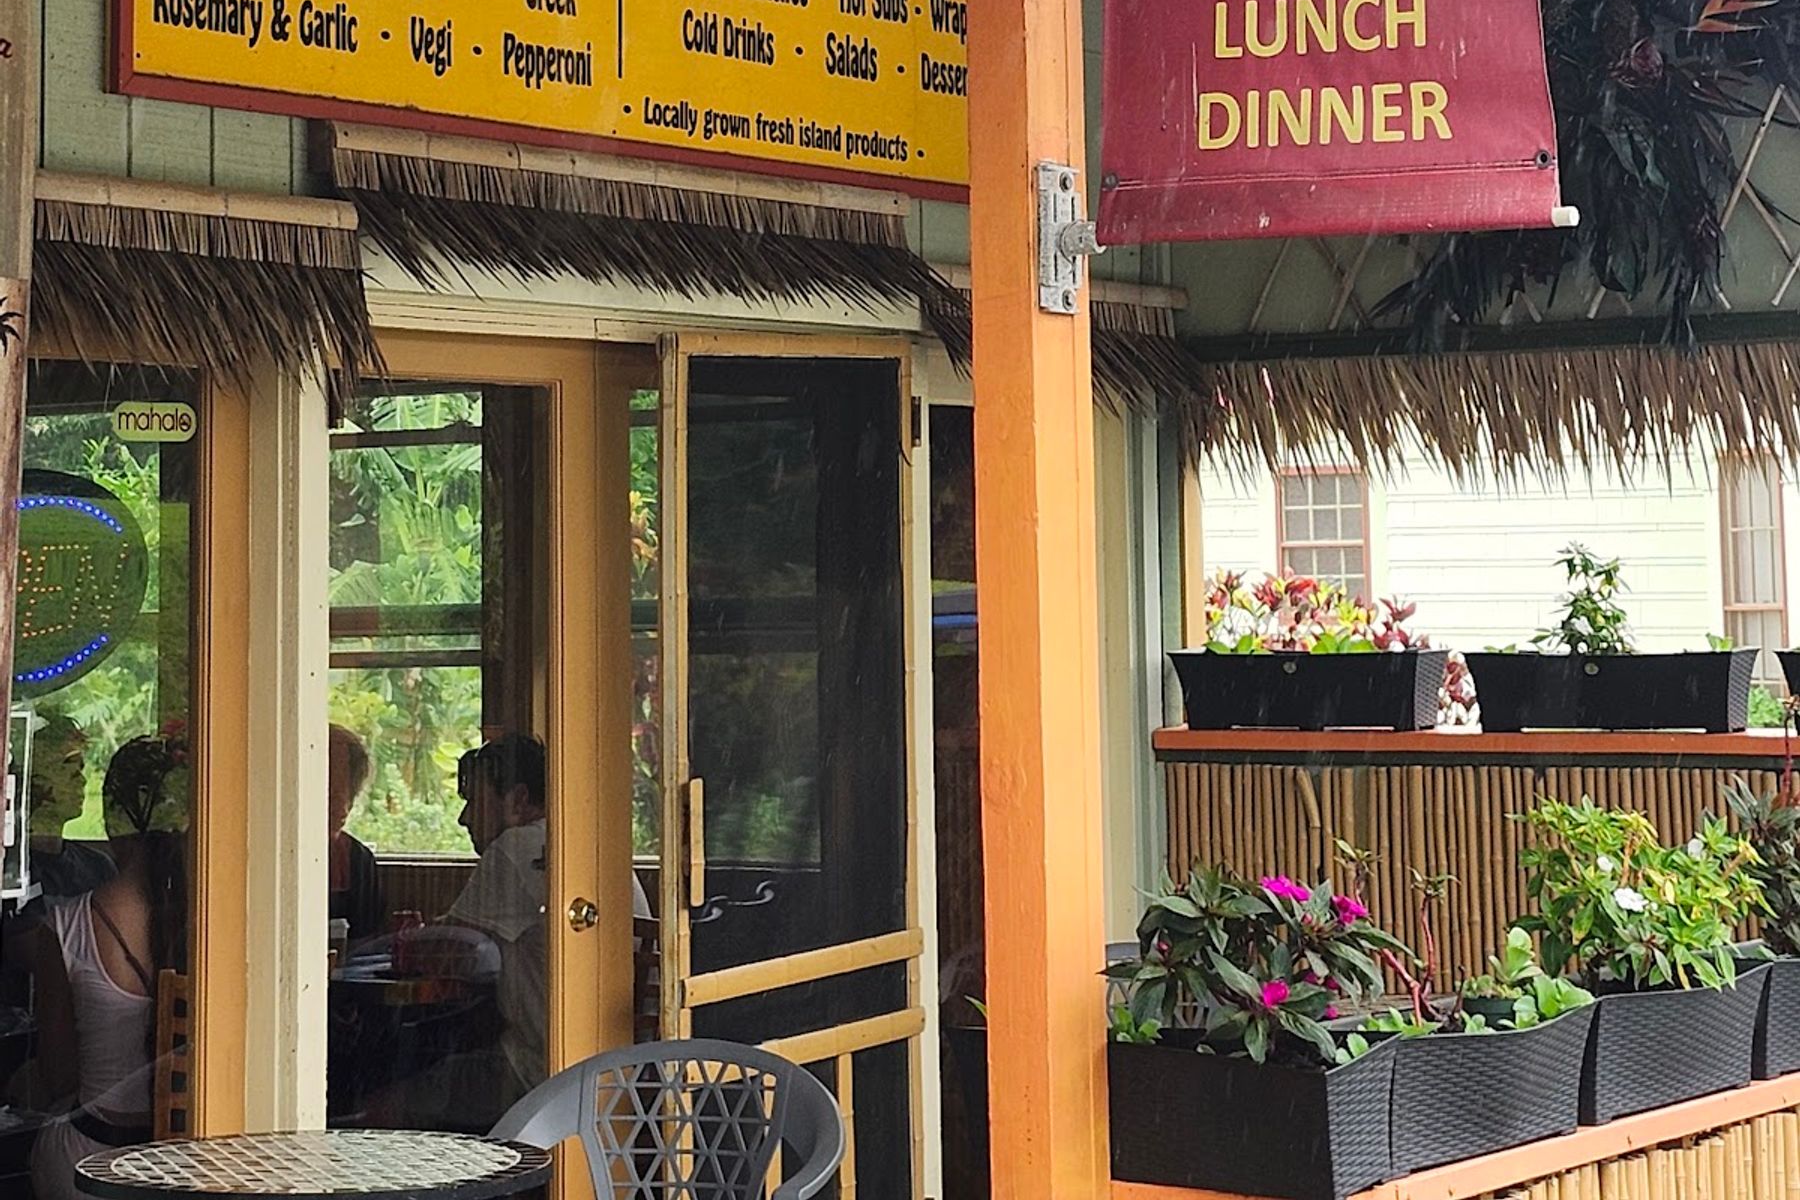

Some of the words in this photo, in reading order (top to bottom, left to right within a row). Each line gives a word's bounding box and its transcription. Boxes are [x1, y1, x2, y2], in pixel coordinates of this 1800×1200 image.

[299, 0, 358, 53] Garlic
[410, 16, 452, 77] Vegi
[503, 32, 592, 90] Pepperoni
[682, 9, 718, 55] Cold
[723, 17, 774, 66] Drinks
[826, 32, 878, 82] Salads
[644, 96, 698, 137] Locally
[703, 109, 750, 140] grown
[755, 112, 794, 145] fresh
[799, 121, 842, 152] island
[846, 130, 908, 162] products
[1197, 80, 1454, 151] DINNER
[118, 407, 192, 432] mahalo
